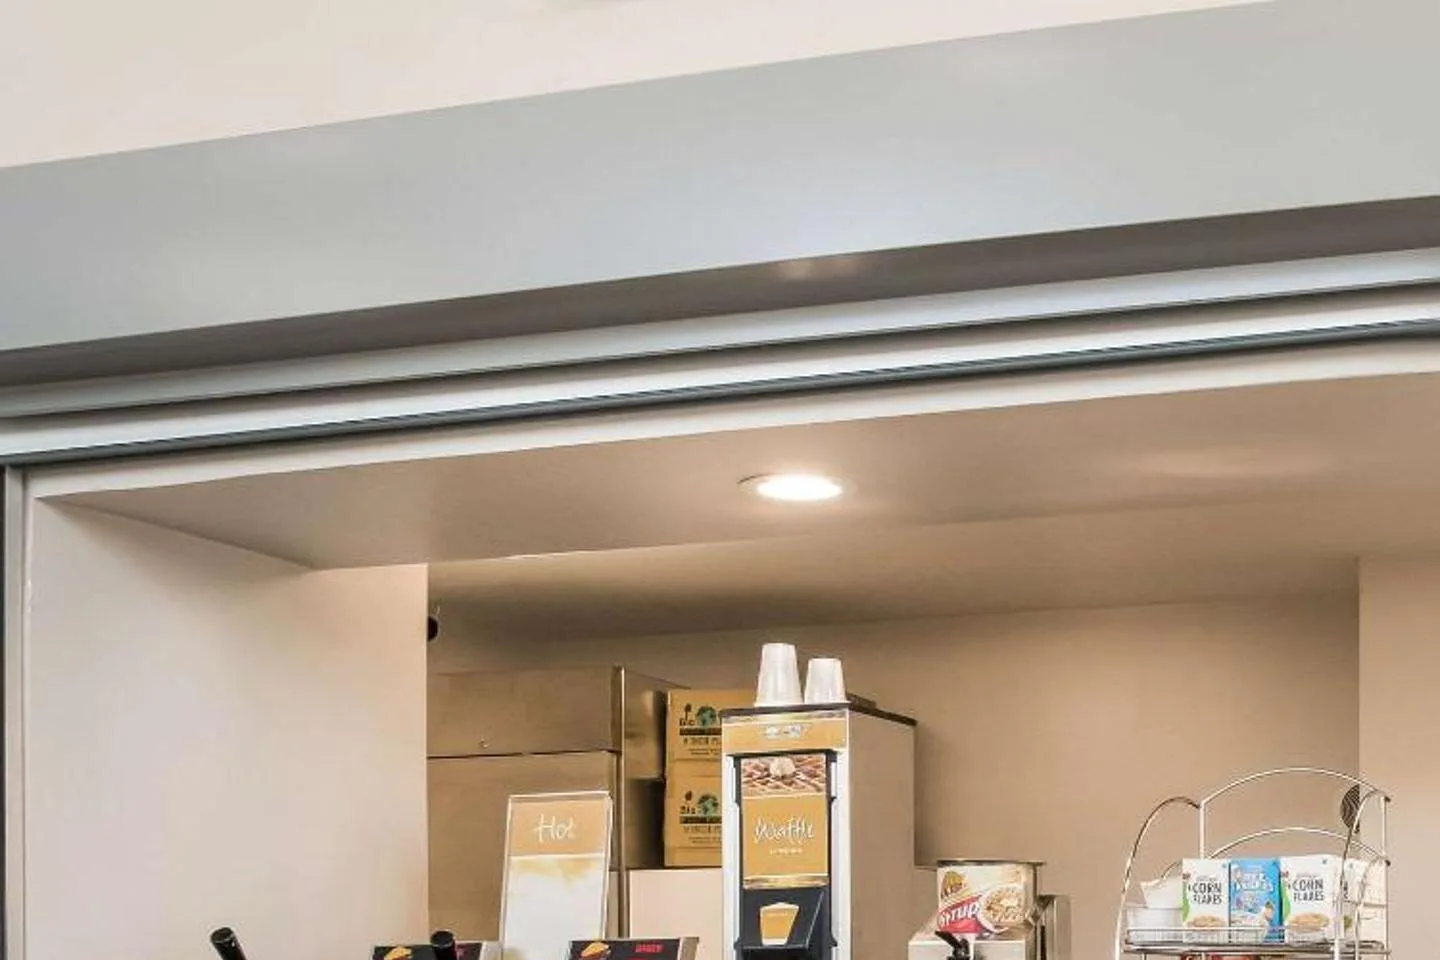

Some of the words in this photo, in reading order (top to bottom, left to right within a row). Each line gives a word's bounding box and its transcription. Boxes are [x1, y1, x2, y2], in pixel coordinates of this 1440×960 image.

[1191, 882, 1222, 894] CORN
[1292, 878, 1324, 892] CORN
[1193, 894, 1223, 905] FLAKES
[1293, 891, 1325, 902] FLAKES
